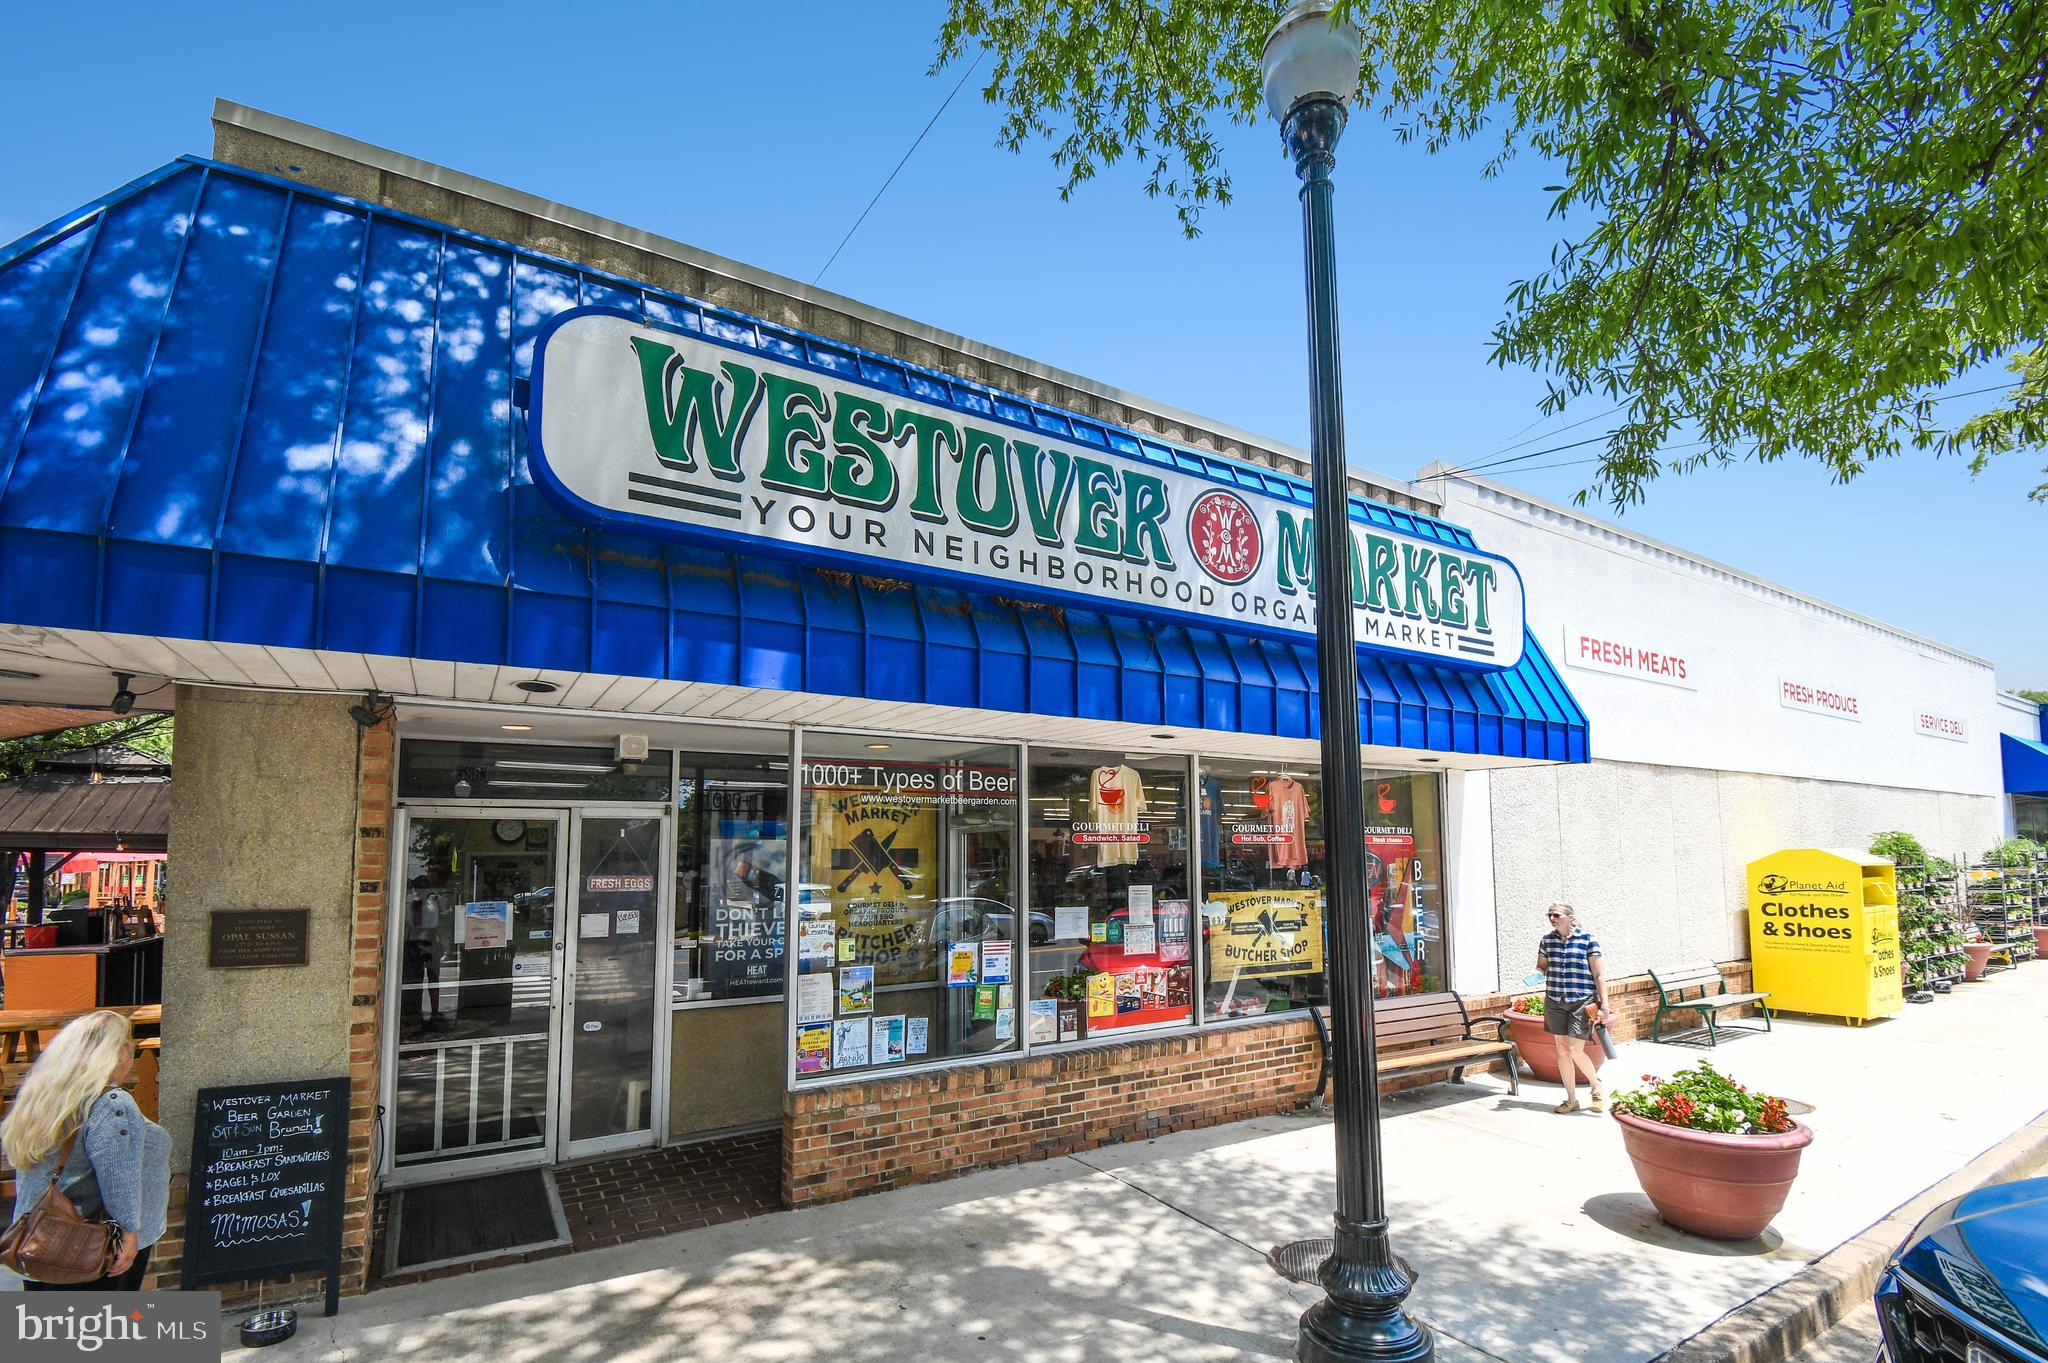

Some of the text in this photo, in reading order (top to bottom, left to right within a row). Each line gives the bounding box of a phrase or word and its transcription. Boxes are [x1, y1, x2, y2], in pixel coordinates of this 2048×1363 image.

[631, 335, 1178, 572] WESTOVER
[751, 496, 1454, 652] YOUR NEIGHBORHOOD ORGA MARKET
[1580, 636, 1687, 679] FRESH MEATS
[1782, 681, 1858, 715] FRESH PRODUCE
[1920, 713, 1964, 737] SERVICE DELI
[801, 763, 1017, 794] 1000+ Types of Beer
[860, 794, 1017, 807] www.westovermarketbeergarden.com
[844, 807, 911, 826] MARKET
[1072, 822, 1150, 832] GOURMET DELI
[1232, 823, 1295, 833] GOURMET DELI
[1397, 827, 1413, 835] DELI
[1121, 834, 1141, 842] Salad
[590, 878, 651, 889] FRESH EGGS
[1789, 881, 1845, 890] Planet Aid
[1227, 895, 1306, 915] WESTOVER MARKET
[1414, 859, 1426, 961] BEER
[1761, 902, 1850, 919] Clothes
[715, 907, 769, 921] DON'T
[222, 931, 296, 941] OPAL SUSSAN
[715, 921, 784, 941] THIEVE
[1762, 921, 1852, 939] & Shoes
[716, 939, 744, 949] TAKE
[746, 937, 775, 947] YOUR
[715, 950, 746, 962] FOR
[750, 948, 762, 960] A
[1225, 939, 1308, 962] BUTCHER SHOP
[1873, 949, 1895, 961] othes
[746, 964, 768, 976] HEAT
[1879, 965, 1896, 978] Shoes
[729, 977, 784, 987] HEATreward.com
[213, 1090, 331, 1111] WESTOVER MARKET
[228, 1106, 311, 1123] BEER GARDEN
[212, 1125, 232, 1139] SAT
[241, 1123, 263, 1137] SUN
[222, 1148, 248, 1160] 10am
[261, 1170, 281, 1183] LOX
